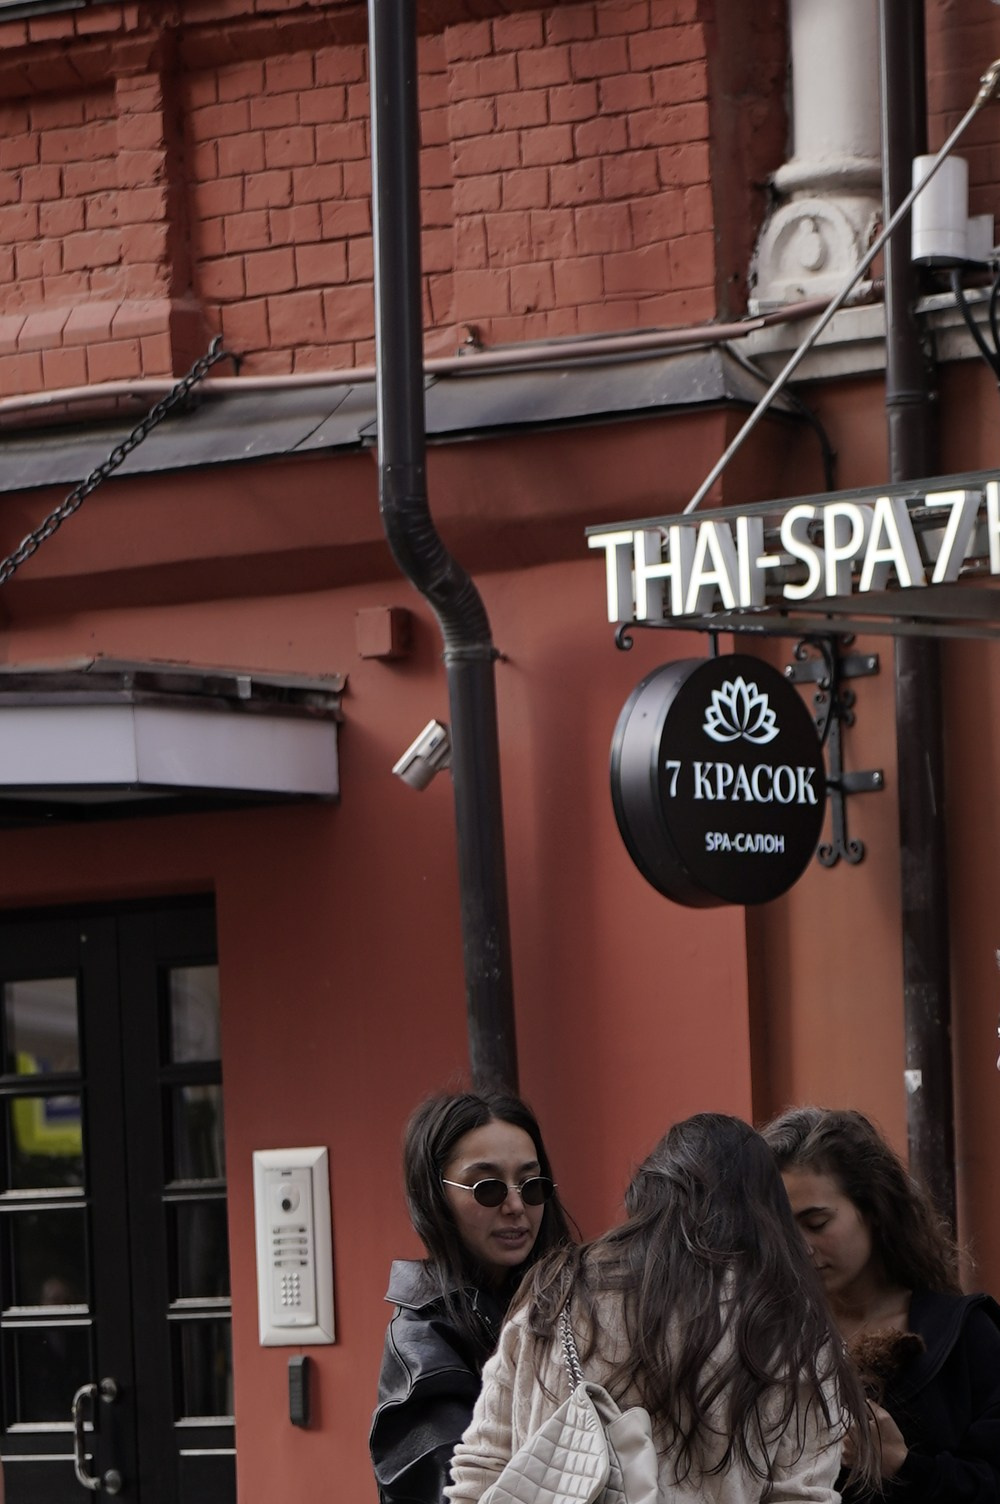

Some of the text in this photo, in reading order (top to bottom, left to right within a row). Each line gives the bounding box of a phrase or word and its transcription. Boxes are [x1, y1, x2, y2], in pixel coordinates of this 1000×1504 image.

[587, 497, 925, 623] THAI-SPA
[924, 489, 981, 584] 7
[665, 760, 818, 805] 7 КРАСОК
[705, 831, 785, 853] SPA-САЛОН
